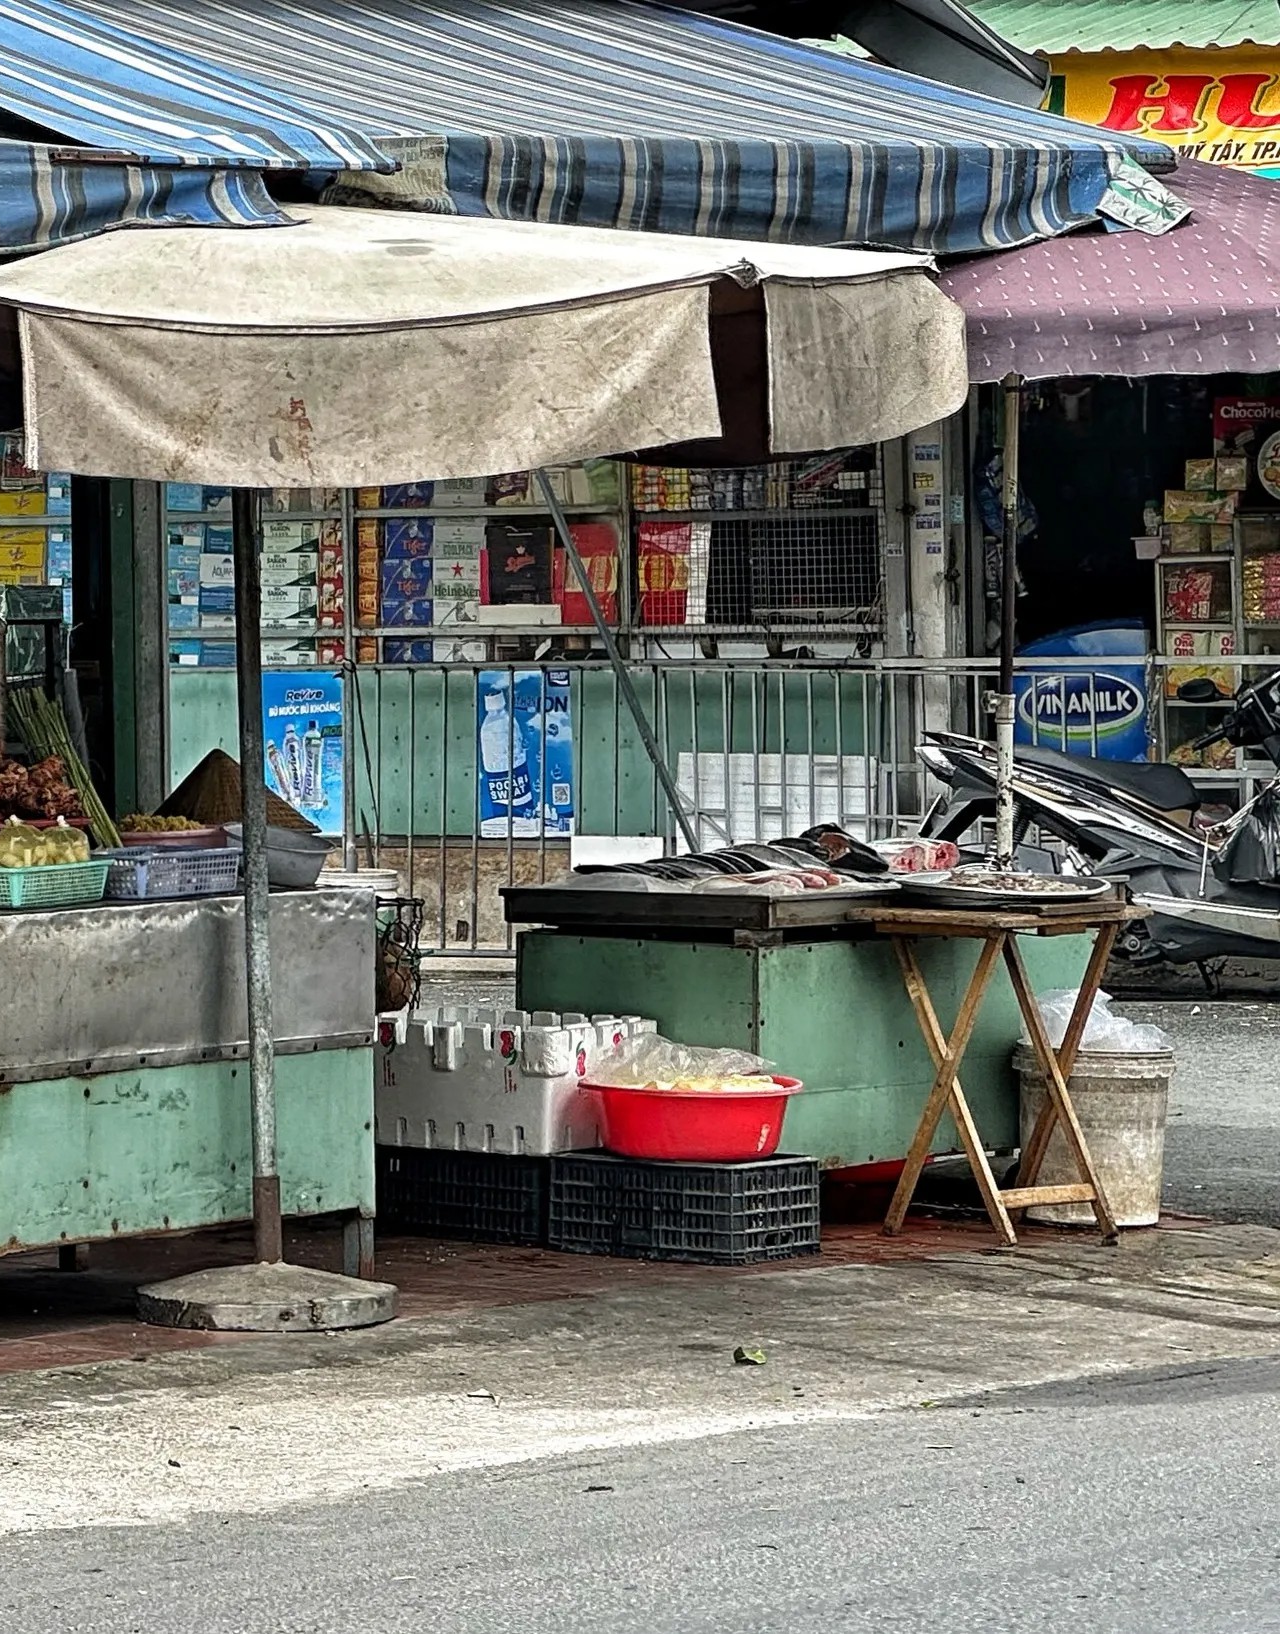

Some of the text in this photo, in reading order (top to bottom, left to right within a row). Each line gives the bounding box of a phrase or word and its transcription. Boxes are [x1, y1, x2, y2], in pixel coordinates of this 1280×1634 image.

[1252, 142, 1280, 159] TP.
[398, 581, 420, 595] Tiger
[434, 583, 480, 597] Heineken
[1037, 690, 1133, 715] VINAMILK
[490, 784, 526, 800] SWAT
